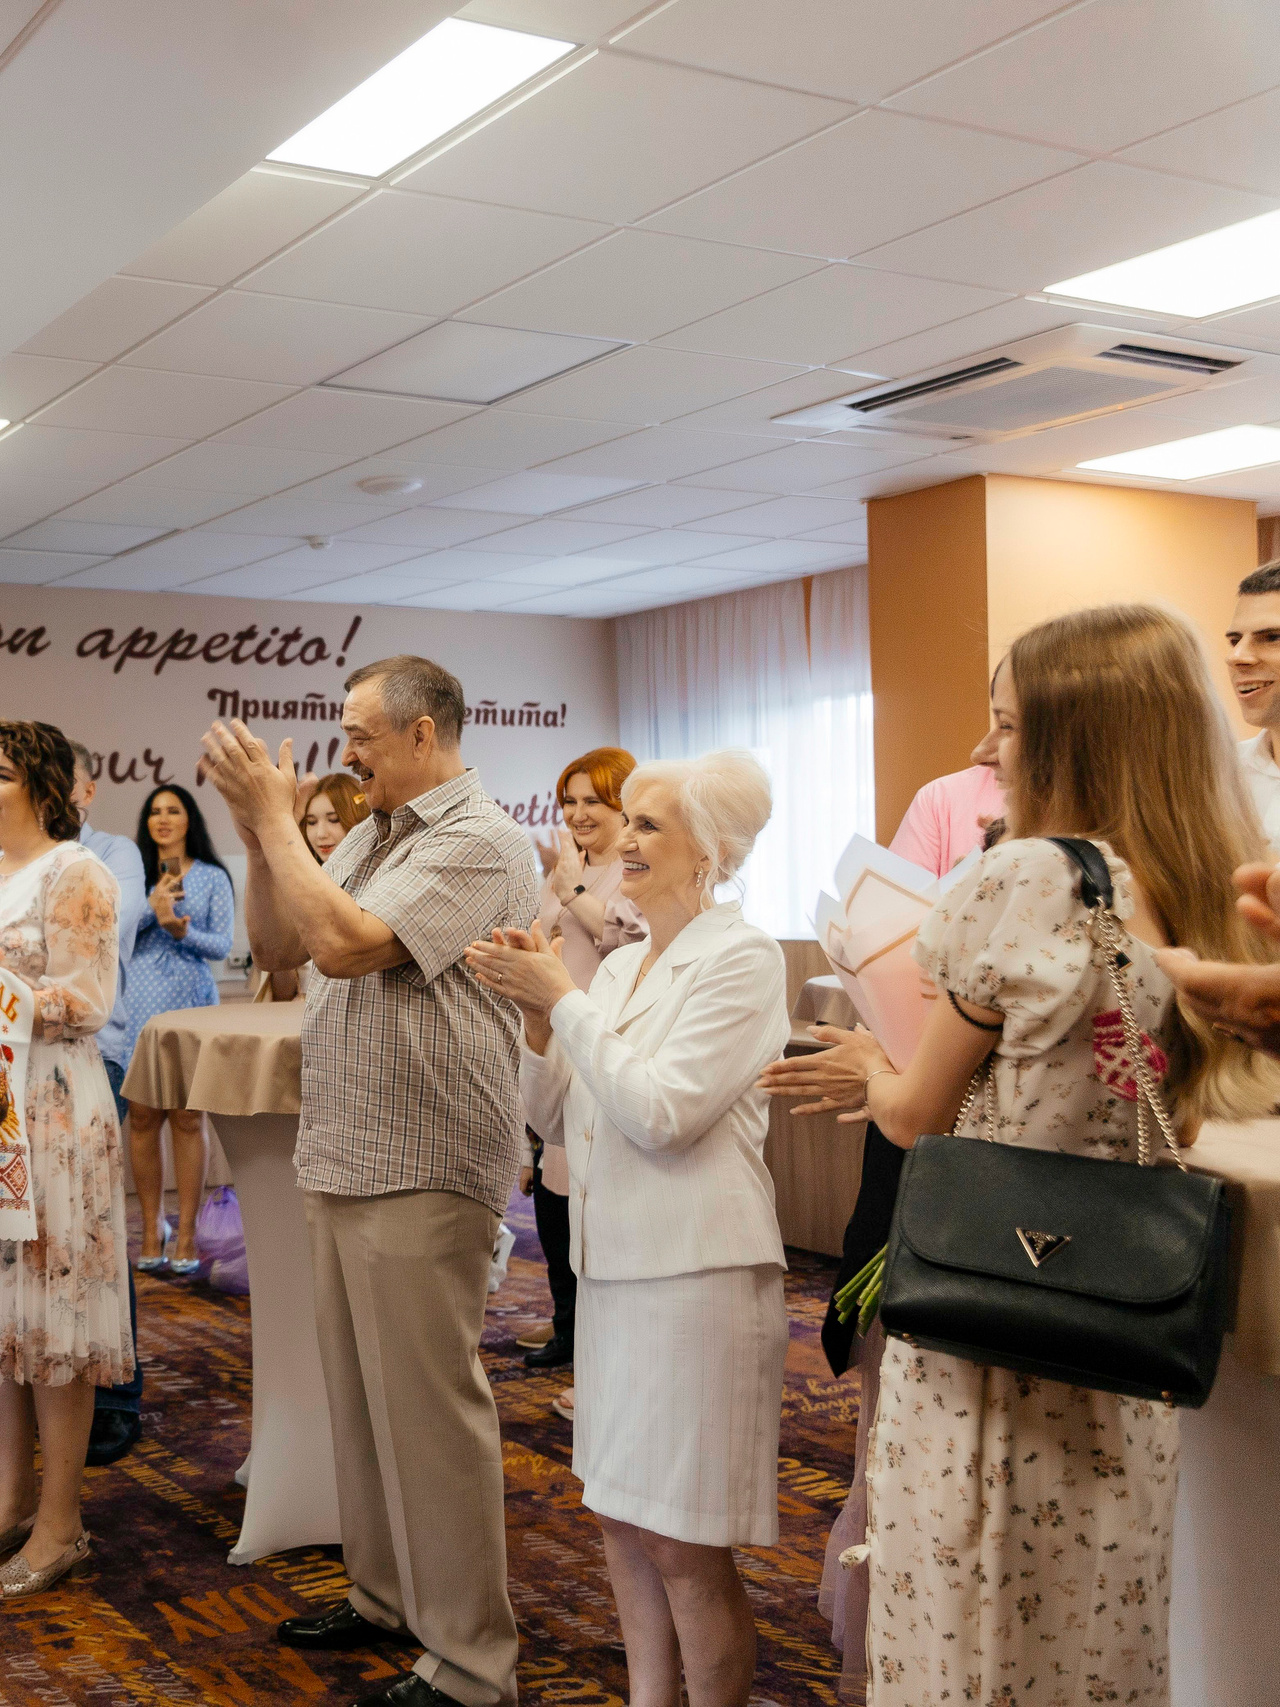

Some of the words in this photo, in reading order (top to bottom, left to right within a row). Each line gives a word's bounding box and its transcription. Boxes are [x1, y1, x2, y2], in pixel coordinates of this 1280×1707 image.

[75, 615, 363, 675] appetito!
[207, 688, 345, 726] Приятн
[463, 699, 567, 728] етита!
